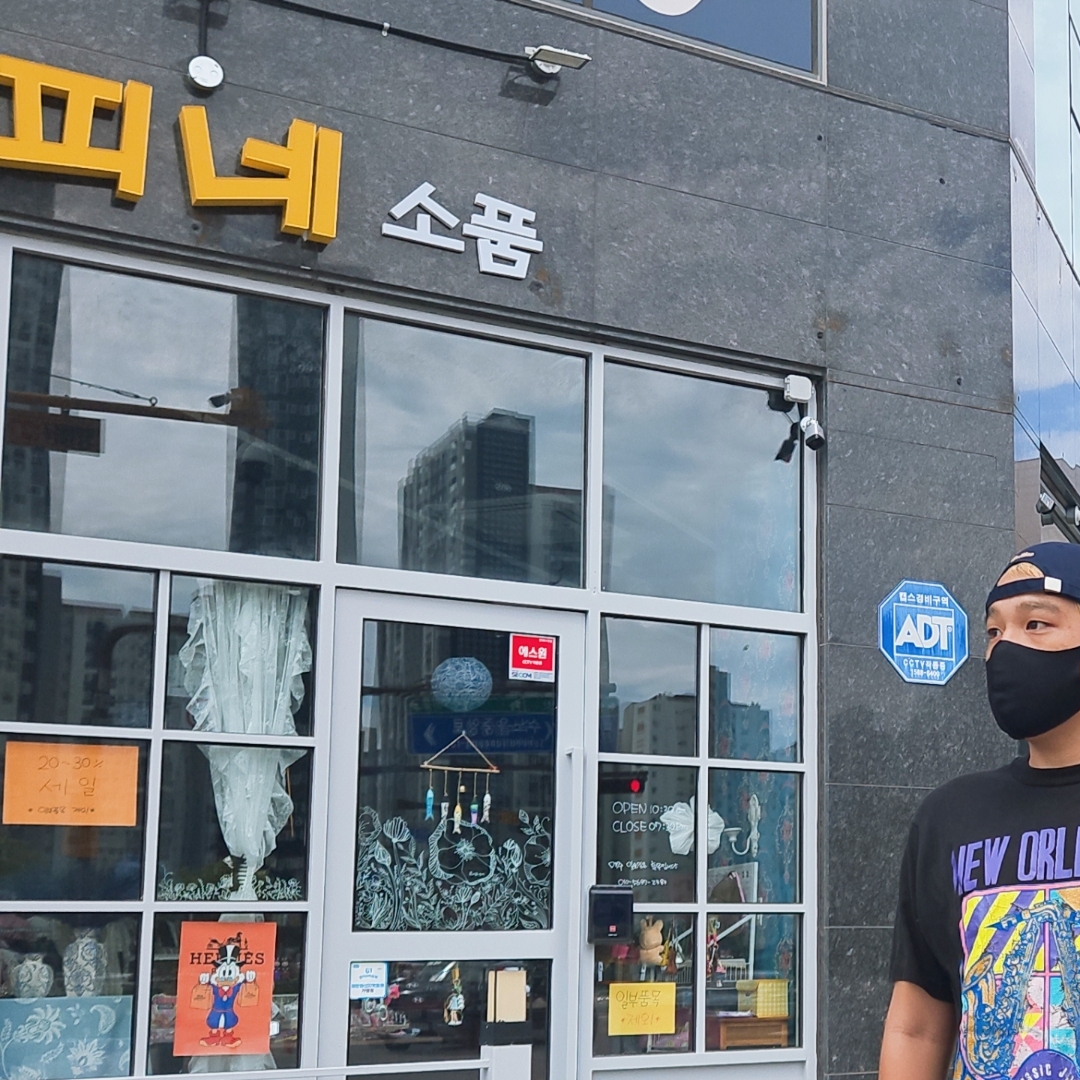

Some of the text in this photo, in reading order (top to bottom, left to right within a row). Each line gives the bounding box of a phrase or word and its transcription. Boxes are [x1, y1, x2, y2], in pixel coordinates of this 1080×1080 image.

[382, 181, 544, 280] 소품
[895, 614, 954, 651] ADT
[518, 645, 547, 660] 에스원
[612, 801, 647, 815] OPEN
[612, 820, 647, 833] CLOSE
[952, 835, 1011, 895] NEW
[615, 990, 661, 1010] 일부품목
